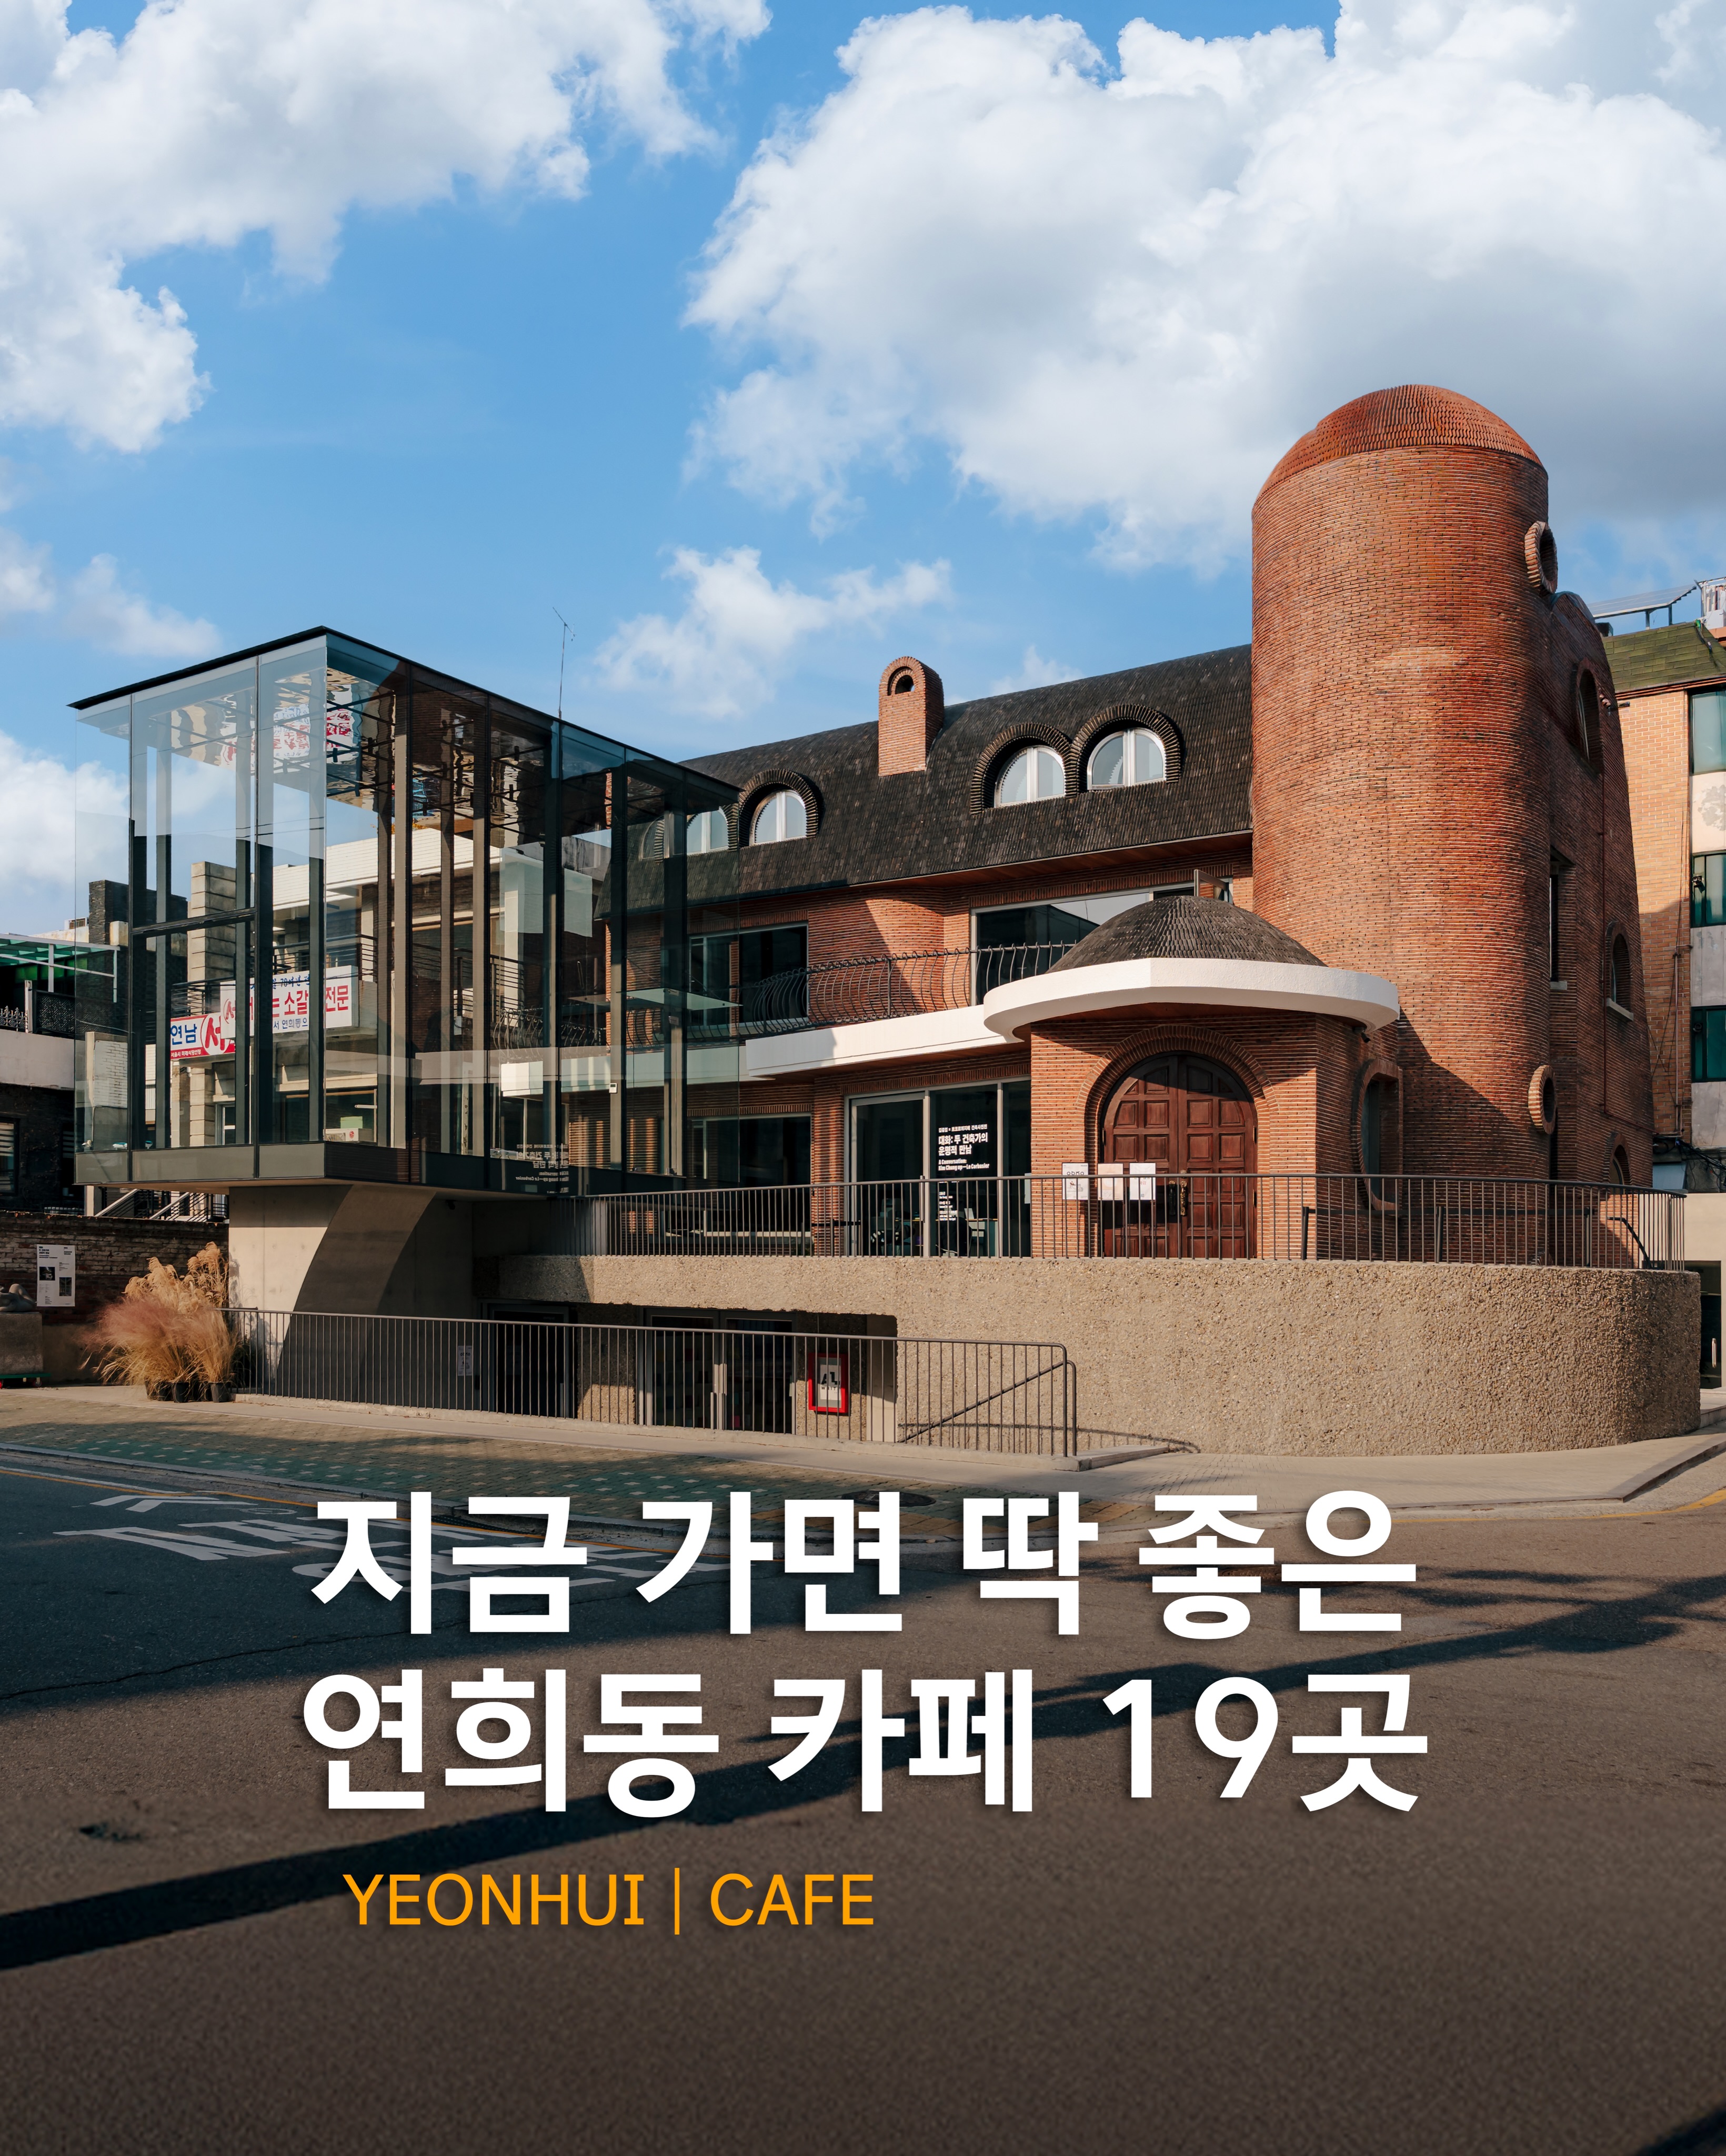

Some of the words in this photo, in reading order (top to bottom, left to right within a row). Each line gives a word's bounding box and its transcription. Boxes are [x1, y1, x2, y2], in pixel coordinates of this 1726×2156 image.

[284, 990, 309, 1015] 소갈
[326, 985, 349, 1012] 전문
[282, 1017, 308, 1030] 연희동으
[170, 1023, 197, 1045] 연남
[938, 1135, 953, 1145] 대화:
[954, 1134, 961, 1144] 두
[962, 1132, 988, 1144] 건축가의
[938, 1145, 957, 1156] 운명적
[959, 1144, 972, 1155] 만남
